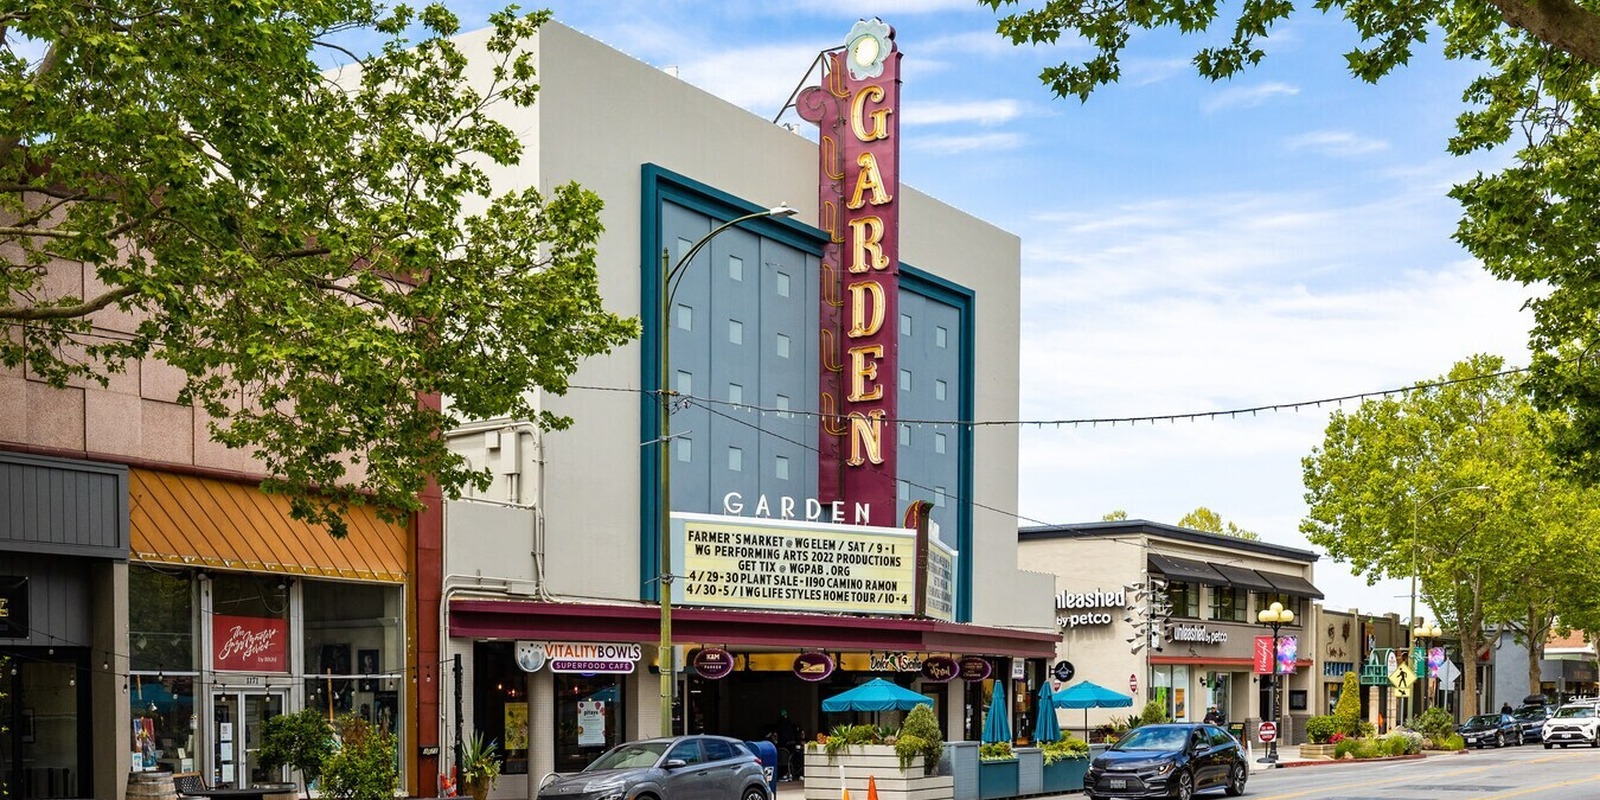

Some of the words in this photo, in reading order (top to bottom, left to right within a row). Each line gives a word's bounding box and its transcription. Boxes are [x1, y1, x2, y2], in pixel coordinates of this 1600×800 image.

[847, 84, 893, 467] GARDEN
[724, 492, 870, 523] GARDEN
[688, 530, 742, 544] FARMER'S
[743, 534, 784, 547] MARKET
[795, 538, 809, 549] WG
[811, 538, 836, 550] ELEM
[848, 541, 865, 552] SAT
[695, 544, 711, 556] WG
[715, 545, 780, 560] PERFORMING
[783, 550, 808, 561] ARTS
[811, 551, 834, 563] 2022
[836, 553, 902, 567] PRODUCTIONS
[738, 560, 757, 571] GET
[759, 561, 776, 572] TIX
[740, 573, 772, 585] PLANT
[826, 577, 863, 590] CAMINO
[865, 580, 898, 592] RAMON
[745, 586, 760, 597] WG
[763, 587, 783, 599] LIFE
[785, 588, 821, 600] STYLES
[823, 590, 849, 602] HOME
[1057, 616, 1068, 628] by
[1070, 612, 1112, 628] petco
[1174, 624, 1206, 642] unleashed
[1211, 631, 1228, 644] petco
[556, 661, 606, 669] SUPERFOOD
[871, 654, 890, 671] Dolce
